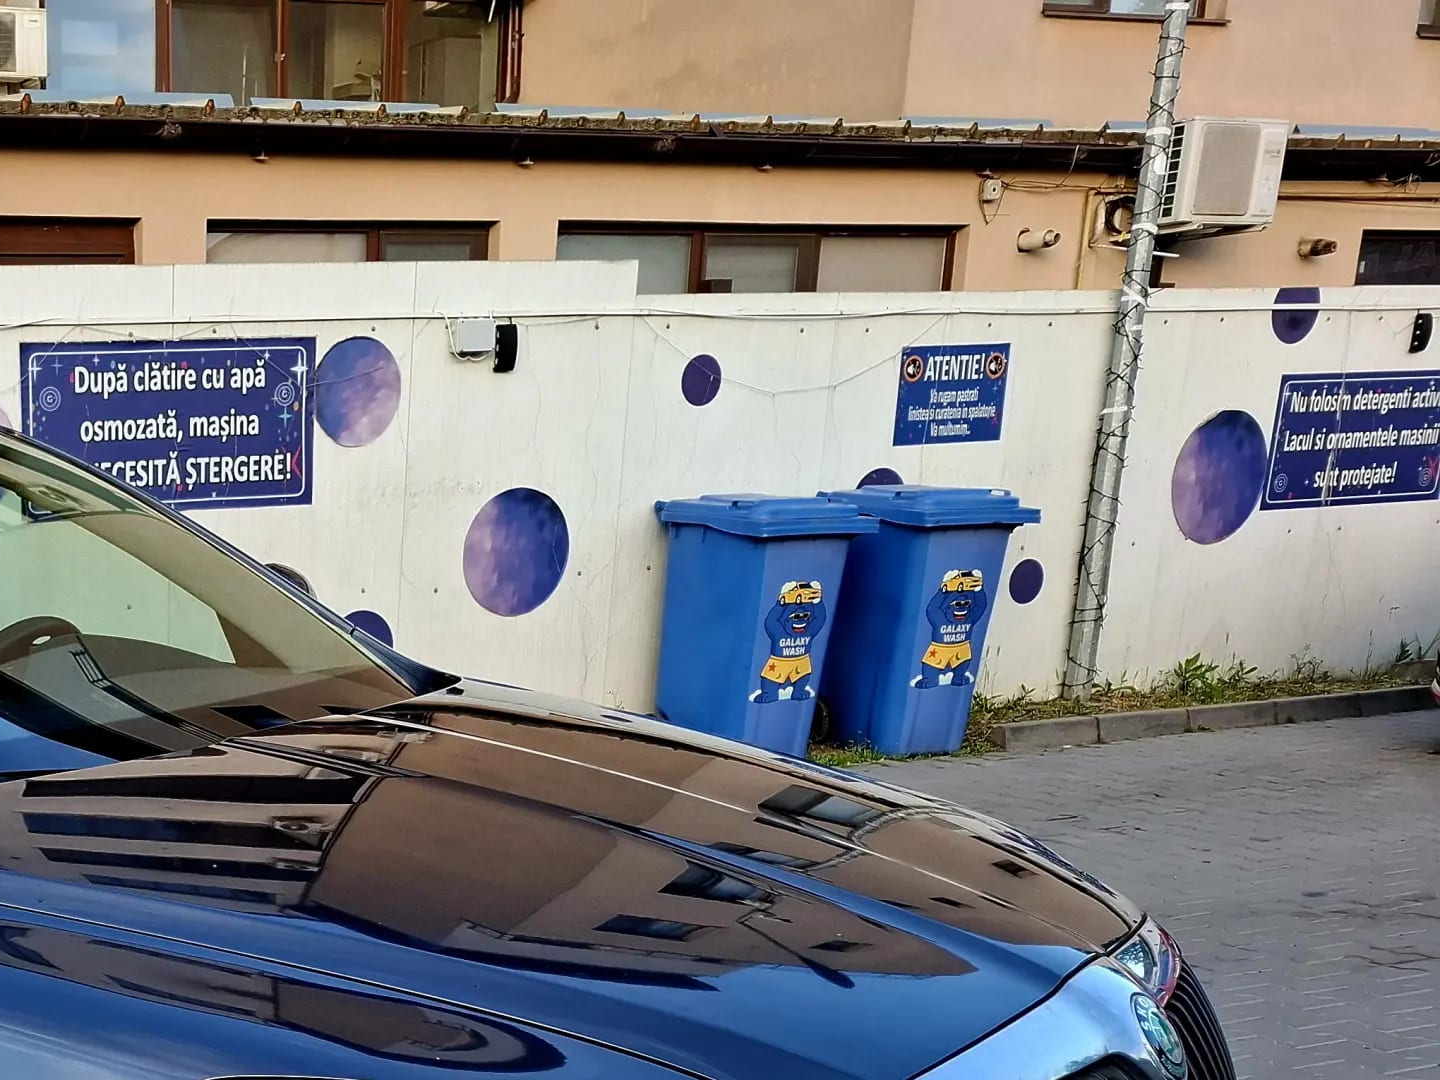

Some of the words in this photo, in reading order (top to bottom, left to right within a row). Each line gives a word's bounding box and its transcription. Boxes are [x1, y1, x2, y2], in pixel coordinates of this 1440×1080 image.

[74, 364, 128, 399] După
[134, 361, 197, 391] clătire
[202, 369, 225, 390] cu
[231, 359, 266, 394] apă
[924, 353, 985, 381] ATENTIE!
[1289, 391, 1308, 413] Nu
[1309, 388, 1351, 413] folosim
[1353, 386, 1412, 415] detergenti
[80, 410, 184, 443] osmozată,
[189, 408, 259, 442] mașina
[1284, 428, 1315, 452] Lacul
[1315, 428, 1326, 450] si
[1326, 424, 1397, 450] ornamentele
[1399, 422, 1440, 446] masinii
[95, 451, 181, 487] CESITĂ
[186, 451, 292, 490] ȘTERGERE!
[1313, 466, 1339, 488] sunt
[1339, 461, 1398, 491] protejate!
[780, 636, 811, 647] GALAXY
[940, 623, 971, 634] GALAXY
[943, 633, 966, 642] WASH
[782, 646, 806, 656] WASH
